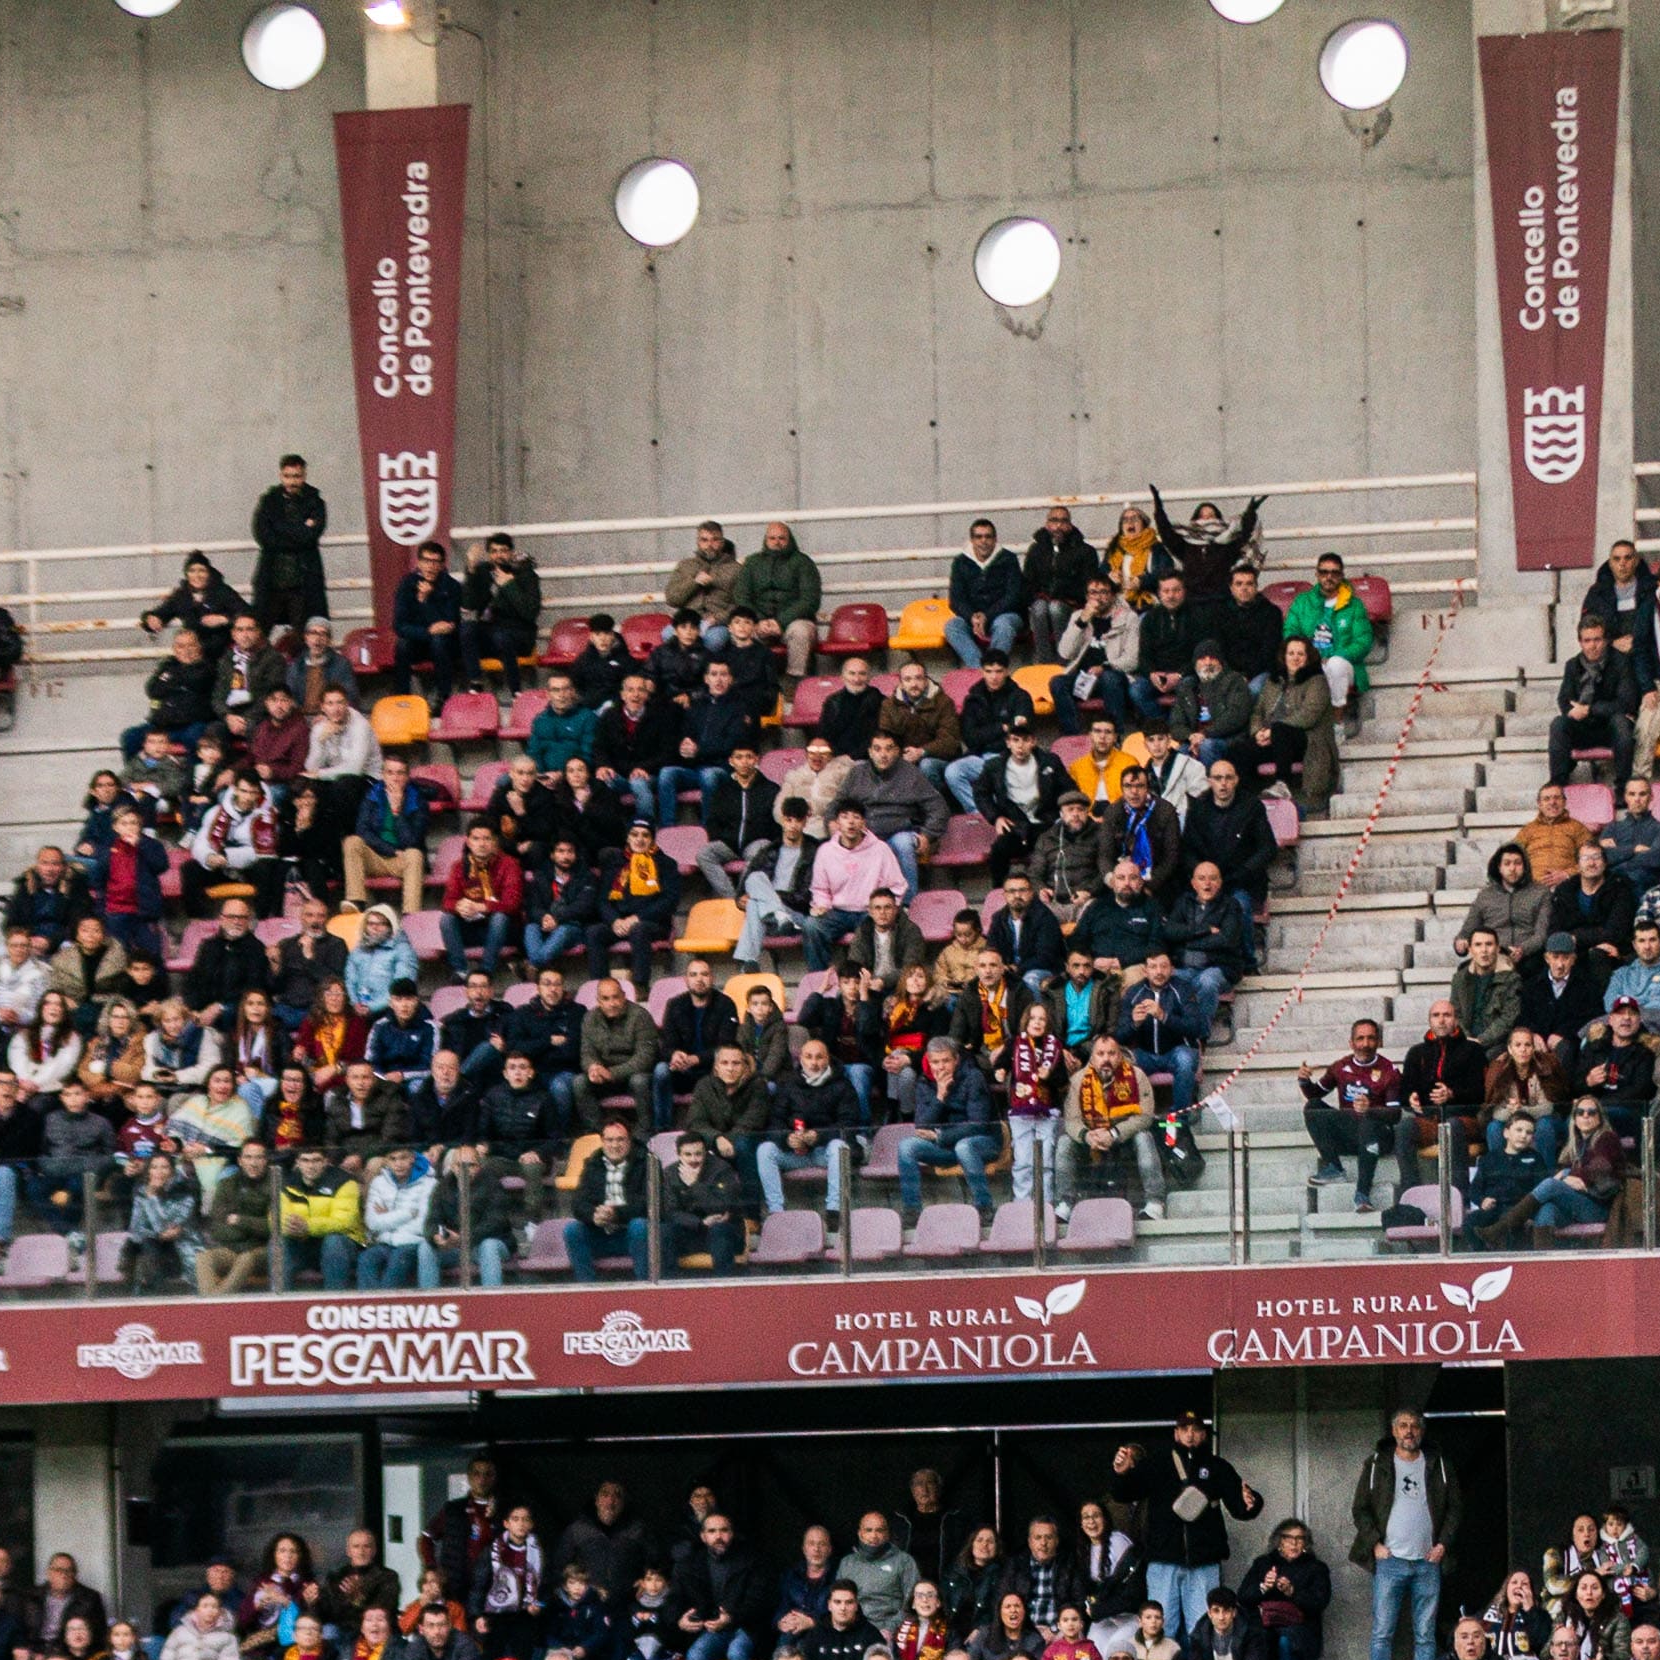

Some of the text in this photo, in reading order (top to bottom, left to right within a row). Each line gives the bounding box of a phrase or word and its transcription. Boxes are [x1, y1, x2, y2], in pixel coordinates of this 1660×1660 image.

[1549, 86, 1581, 330] de Pontevedra
[400, 160, 434, 397] de Pontevedra
[1518, 185, 1547, 331] Concello
[371, 256, 400, 398] Concello
[307, 1303, 460, 1331] CONSERVAS
[833, 1306, 1014, 1331] HOTEL RURAL
[1255, 1294, 1439, 1318] HOTEL RURAL
[75, 1340, 205, 1368] PESCAMAR
[229, 1328, 536, 1387] PESCAMAR
[563, 1328, 692, 1355] PESCAMAR
[787, 1331, 1099, 1376] CAMPANIOLA
[1206, 1319, 1526, 1370] CAMPANIOLA
